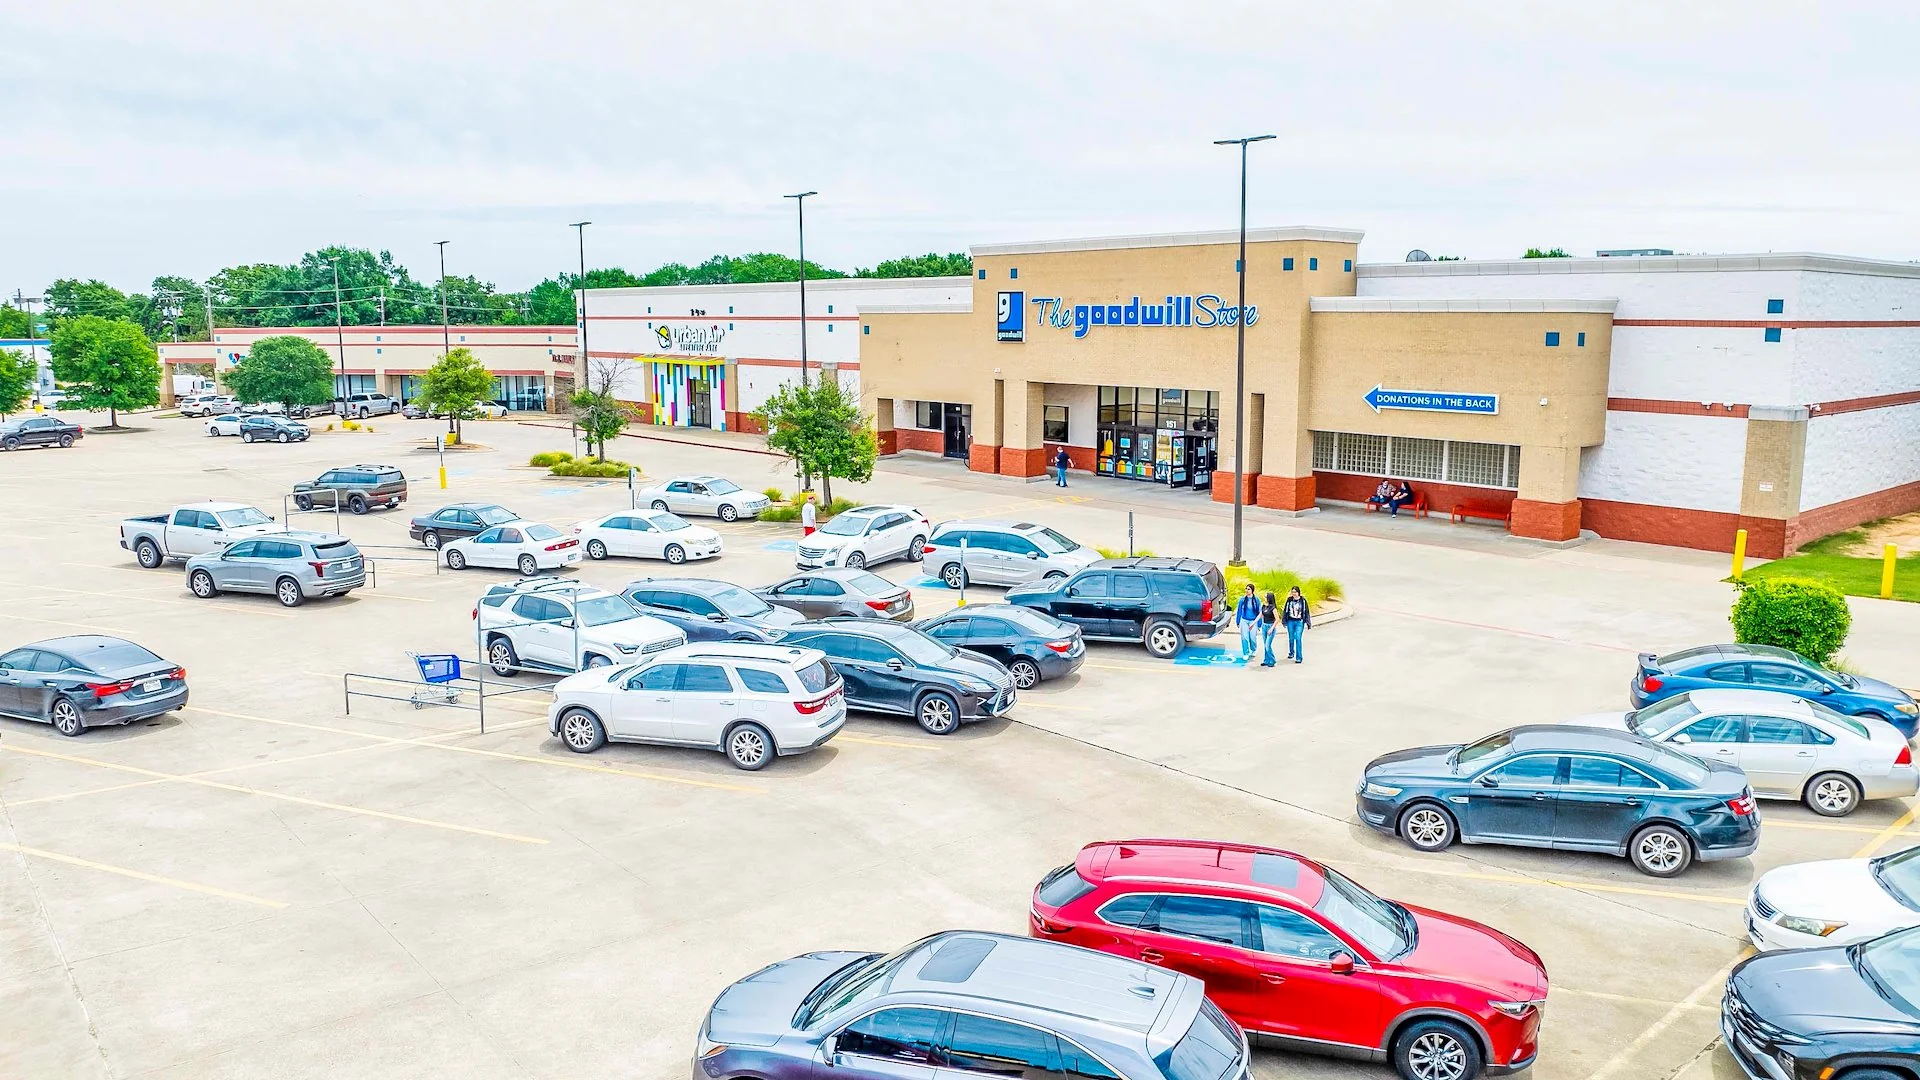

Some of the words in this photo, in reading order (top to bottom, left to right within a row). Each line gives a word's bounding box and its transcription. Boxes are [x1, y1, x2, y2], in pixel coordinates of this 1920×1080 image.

[1031, 296, 1073, 329] The
[1073, 295, 1193, 338] goodwill
[1376, 394, 1431, 405] DONATIONS
[1432, 397, 1442, 406] IN
[1445, 398, 1463, 407] THE
[1465, 399, 1492, 409] BACK
[1165, 420, 1177, 428] 151
